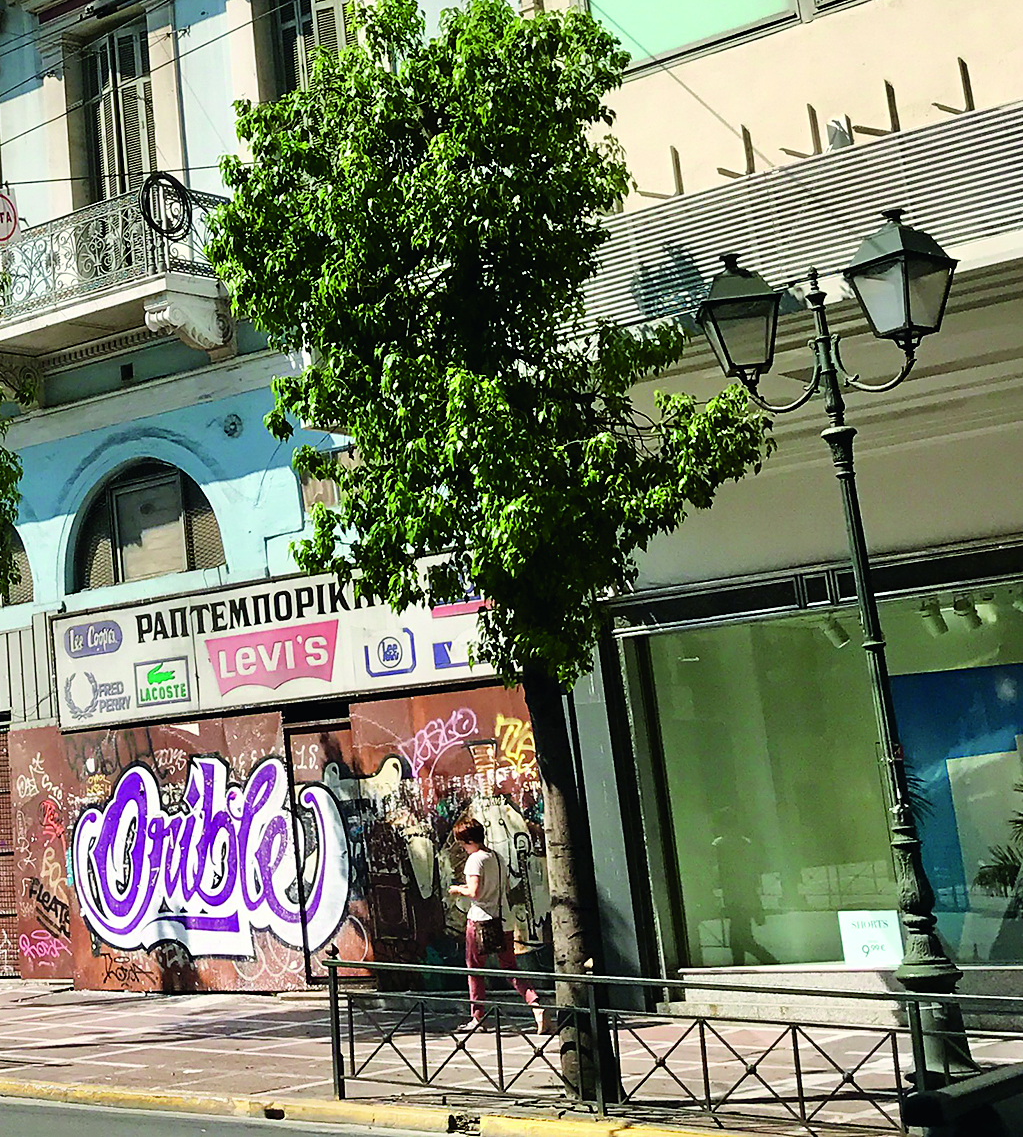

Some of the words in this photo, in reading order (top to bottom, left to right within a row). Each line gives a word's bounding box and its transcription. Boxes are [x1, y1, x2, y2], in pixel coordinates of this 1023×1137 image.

[99, 681, 124, 697] FRED
[140, 683, 187, 702] LACOSTE
[99, 695, 131, 713] PERRY
[851, 920, 889, 929] SHORTS
